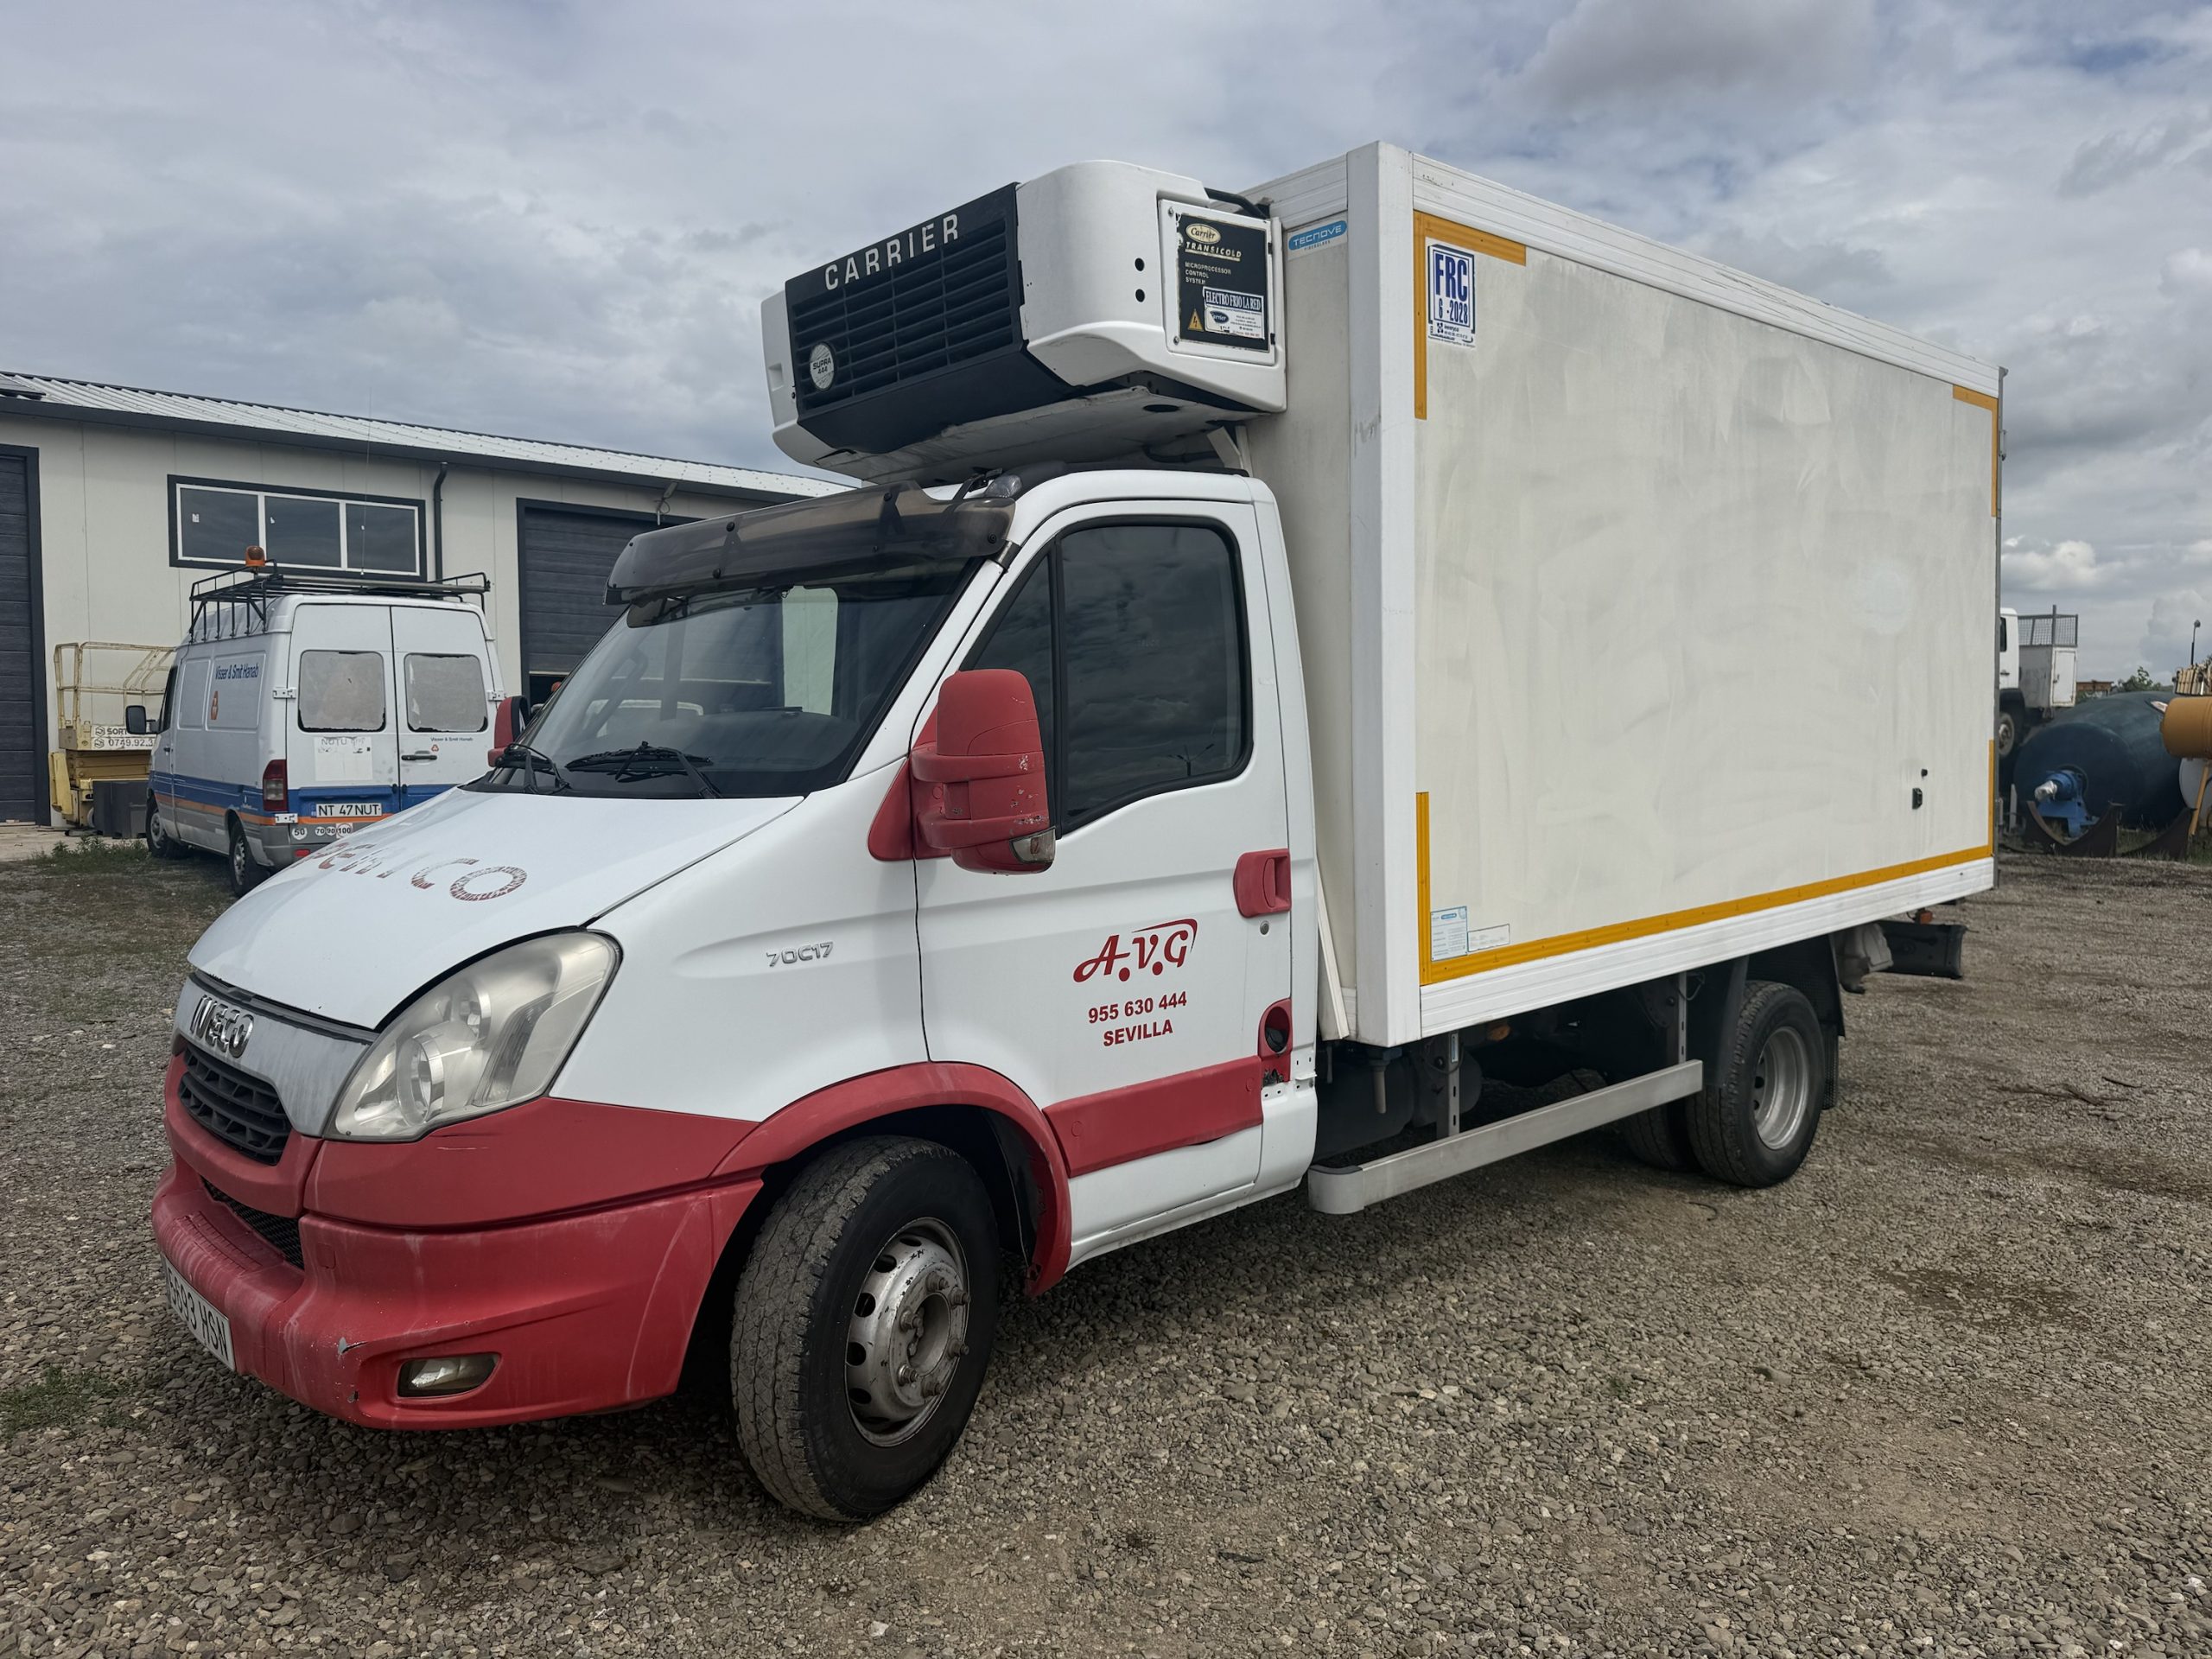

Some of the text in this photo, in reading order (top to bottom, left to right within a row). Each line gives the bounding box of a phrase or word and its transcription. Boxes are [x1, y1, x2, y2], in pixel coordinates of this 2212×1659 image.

[1191, 226, 1216, 241] Carrier
[1294, 225, 1342, 245] TECNOVE
[824, 213, 959, 290] CARRIER
[1185, 242, 1242, 257] TRANSICOLD
[1185, 262, 1231, 275] MICROPROCESSOR
[1185, 270, 1210, 278] CONTROL
[1435, 253, 1467, 302] FRC
[1205, 290, 1230, 307] ELECTRO
[1230, 295, 1243, 308] FRIO
[1250, 297, 1262, 310] RED
[813, 358, 832, 370] SUPRA
[318, 804, 379, 817] NT 47 NUT
[294, 828, 305, 836] 50
[766, 941, 834, 968] 70C17
[1088, 991, 1187, 1024] 955 630 444
[190, 994, 255, 1058] IVECO
[1103, 1019, 1173, 1047] SEVILLA
[198, 1300, 229, 1362] HSN
